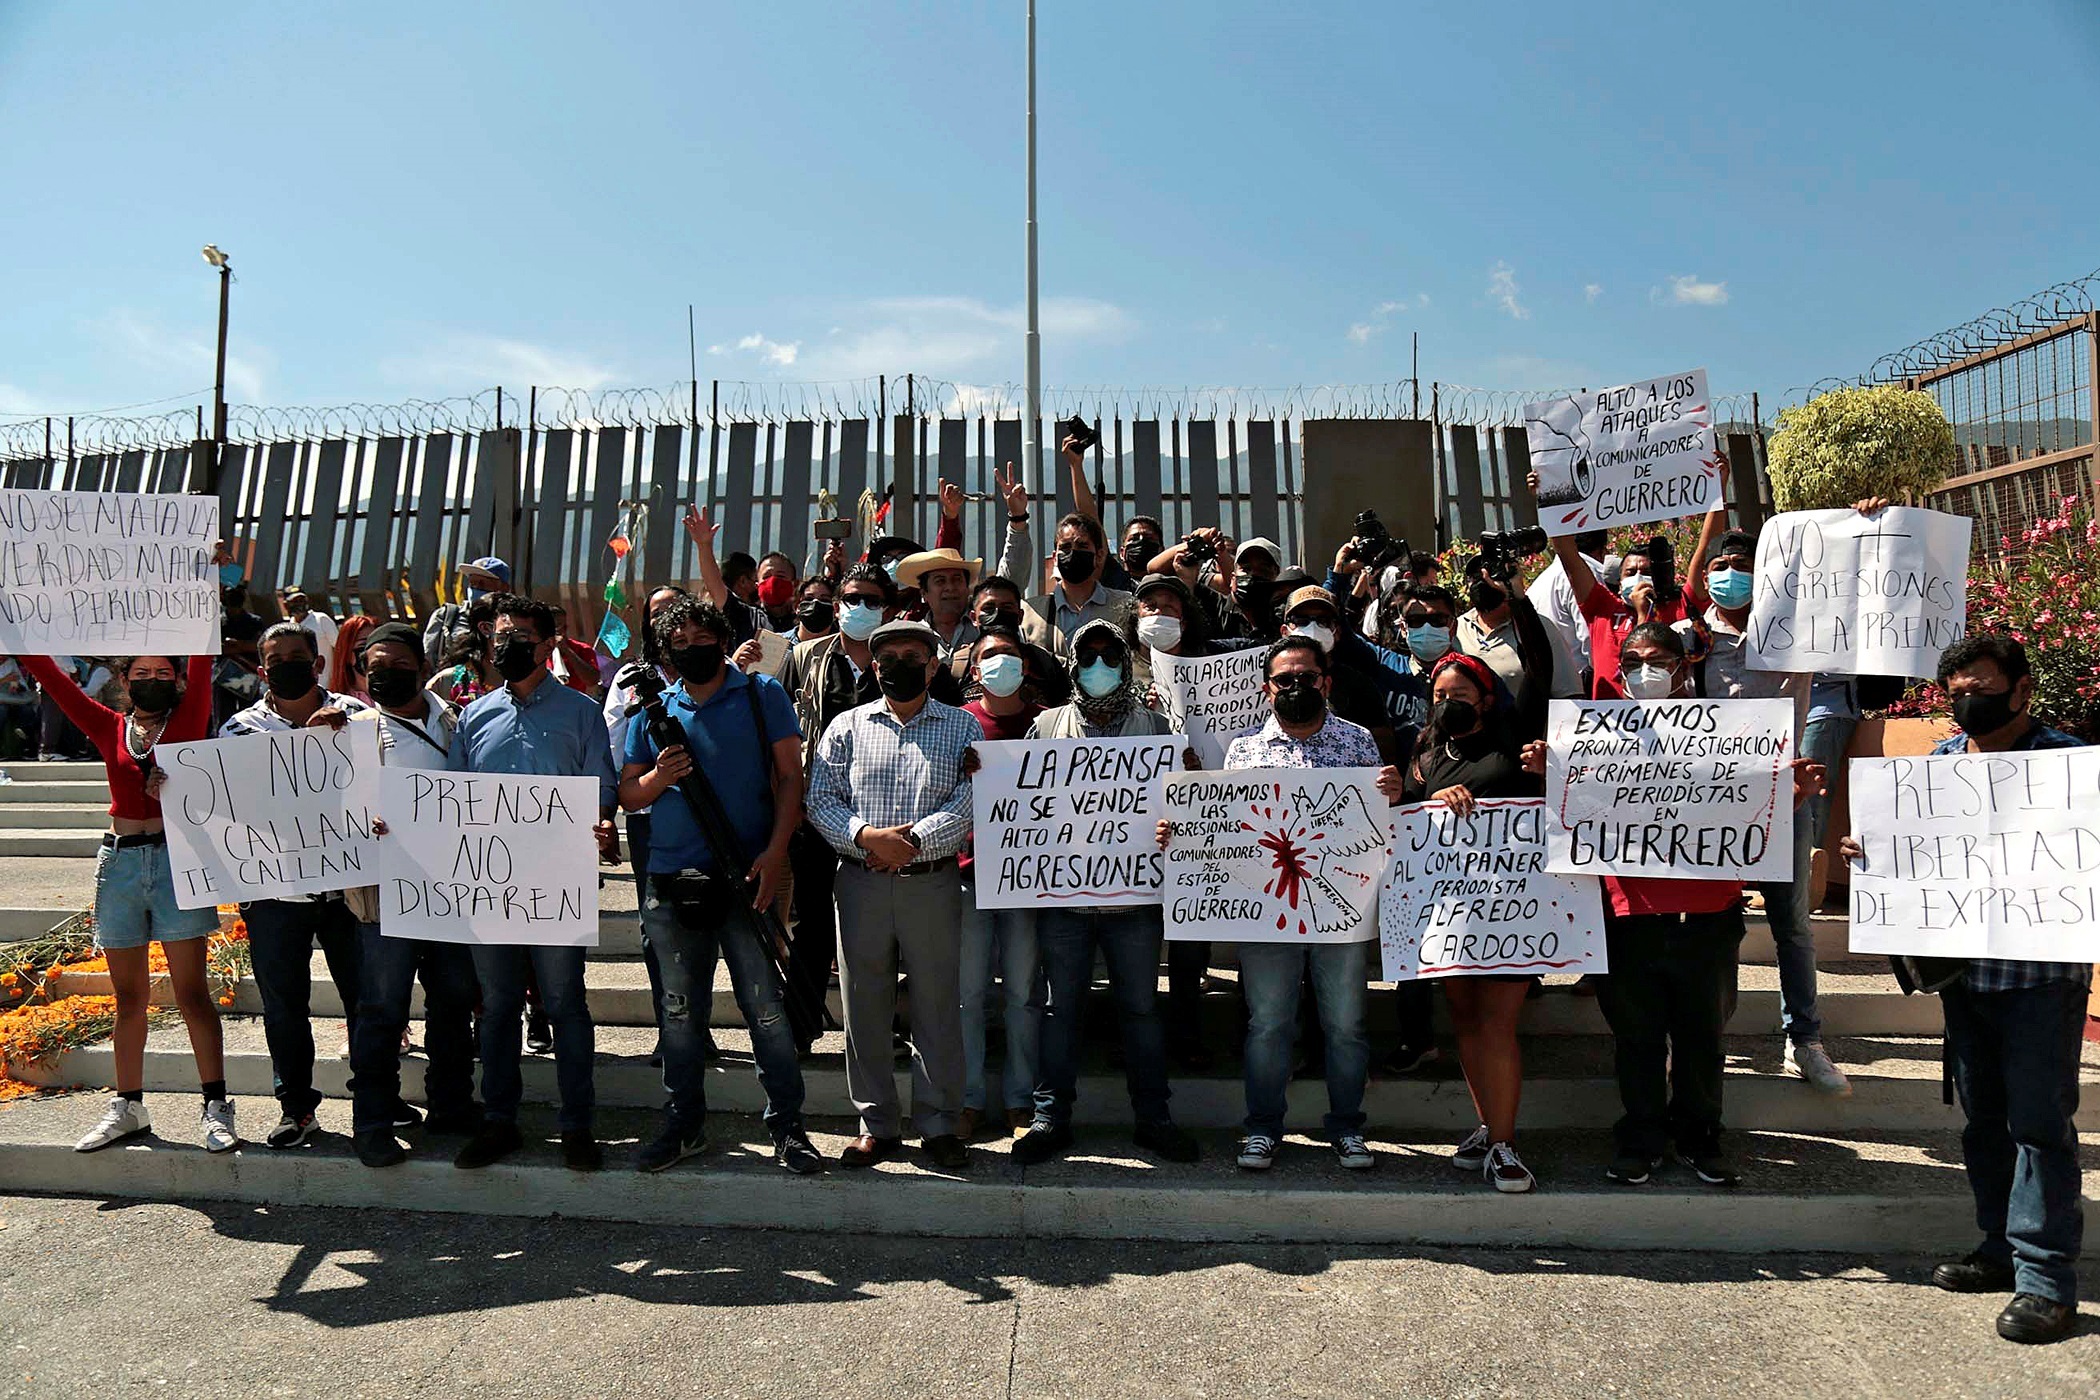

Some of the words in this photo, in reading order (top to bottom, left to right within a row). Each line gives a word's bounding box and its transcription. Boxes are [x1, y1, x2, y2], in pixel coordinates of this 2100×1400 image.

[1597, 386, 1636, 414] ALTO
[1646, 384, 1657, 403] A
[1666, 375, 1695, 401] LOS
[1600, 402, 1681, 434] ATAQUES
[1596, 431, 1704, 468] COMUNICADORES
[1637, 428, 1649, 443] A
[1634, 463, 1653, 480] DE
[1595, 475, 1708, 521] GUERRERO
[45, 495, 80, 533] SE
[95, 495, 181, 539] MATA
[188, 503, 219, 541] LA
[1763, 518, 1824, 569] NO
[1758, 568, 1954, 611] AGRESIONES
[65, 588, 219, 626] PERIODISTAS
[1753, 615, 1795, 655] VS
[1804, 615, 1850, 655] LA
[1861, 611, 1963, 651] PRENSA
[1173, 651, 1266, 686] ESCLARECIMIE
[1186, 686, 1197, 701] A
[1208, 674, 1257, 698] CASOS
[1204, 708, 1273, 734] ASESINA
[1574, 703, 1721, 735] EXIGIMOS
[1568, 738, 1641, 761] PRONTA
[1648, 729, 1788, 757] INVESTIGACIÓN
[176, 747, 236, 826] SI
[270, 730, 355, 798] NOS
[1016, 749, 1058, 790] LA
[1064, 744, 1176, 787] PRENSA
[1567, 765, 1587, 785] DE
[1711, 761, 1739, 781] DE
[405, 773, 574, 828] PRENSA
[1166, 782, 1270, 810] REPUDIAMOS
[1883, 751, 2100, 820] RESPET
[989, 797, 1019, 824] NO
[1030, 795, 1057, 822] SE
[1070, 786, 1148, 815] VENDE
[1201, 803, 1229, 820] LAS
[1310, 795, 1350, 829] LIBERTAD
[1654, 806, 1679, 822] EN
[1000, 827, 1049, 849] ALTO
[1056, 822, 1074, 845] A
[1086, 820, 1130, 845] LAS
[1171, 820, 1242, 838] AGRESIONES
[1332, 817, 1345, 829] DE
[1411, 807, 1546, 852] JUSTICI
[1169, 845, 1263, 862] COMUNICADORES
[1203, 834, 1216, 848] A
[1570, 820, 1767, 868] GUERRERO
[1855, 827, 2100, 881] LIBERTAD
[181, 867, 220, 897] TE
[239, 846, 362, 885] CALLAN
[452, 834, 512, 885] NO
[997, 852, 1165, 895] AGRESIONES
[1202, 862, 1221, 872] DEL
[1393, 859, 1416, 884] AL
[1424, 848, 1544, 878] COMPAÑER
[1177, 872, 1230, 887] ESTADO
[1204, 885, 1222, 897] DE
[1429, 877, 1528, 901] PERIODISTA
[392, 878, 582, 924] DISPAREN
[1172, 897, 1263, 924] GUERRERO
[1415, 898, 1539, 928] ALFREDO
[1855, 889, 1896, 927] DE
[1917, 885, 2096, 930] EXPRESI
[1418, 931, 1559, 965] CARDOSO
